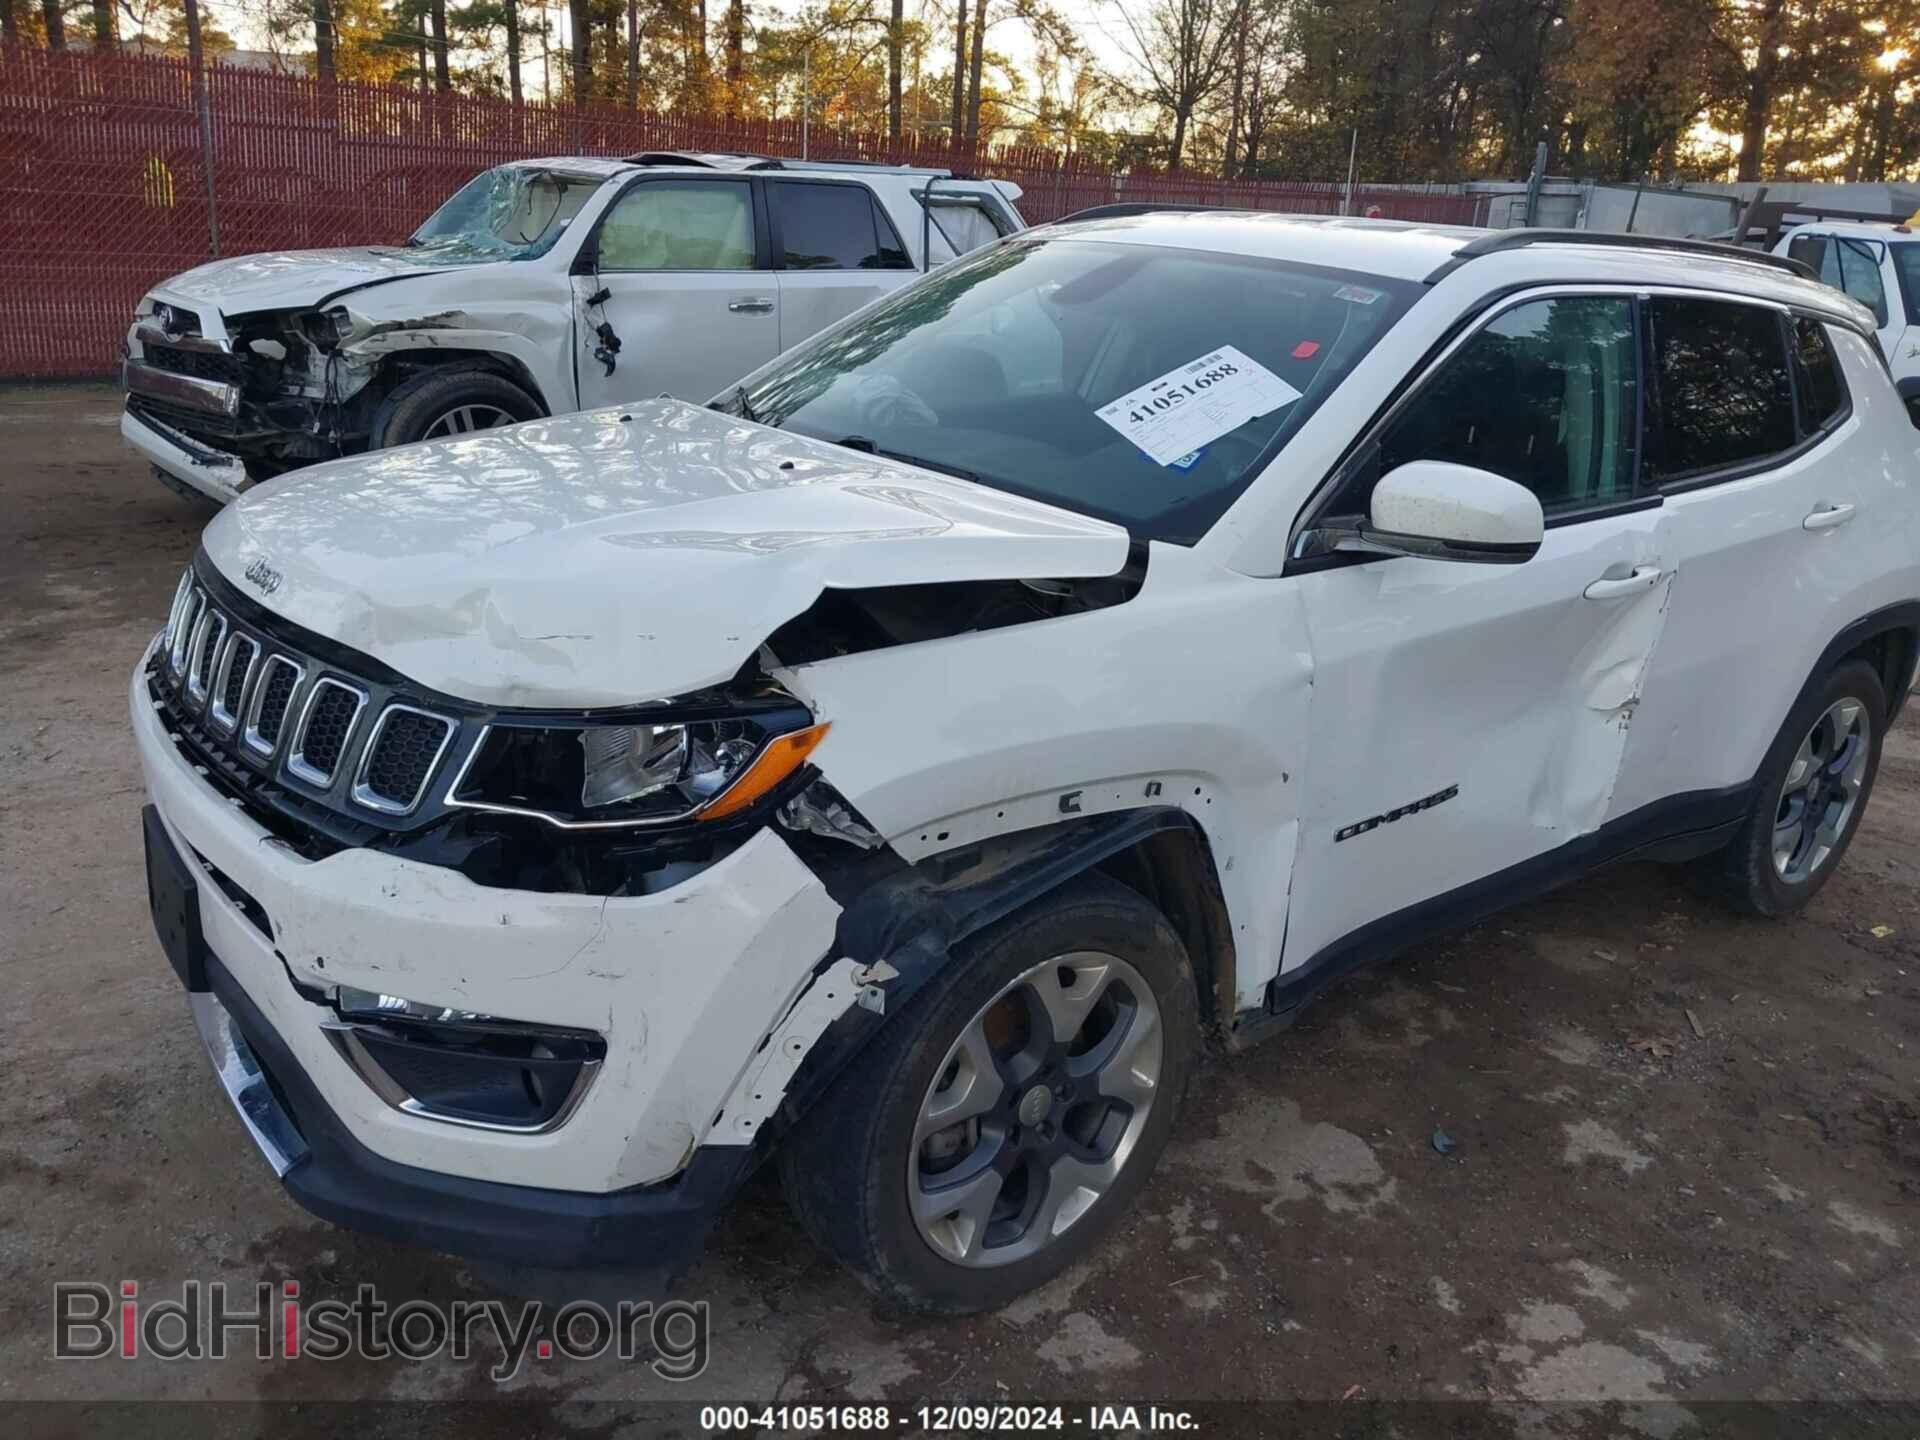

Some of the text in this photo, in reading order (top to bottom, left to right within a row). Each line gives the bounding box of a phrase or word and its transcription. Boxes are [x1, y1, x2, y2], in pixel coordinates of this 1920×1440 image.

[1130, 362, 1239, 425] 41051688
[245, 559, 281, 597] Jeep
[1334, 783, 1459, 842] COMPASS
